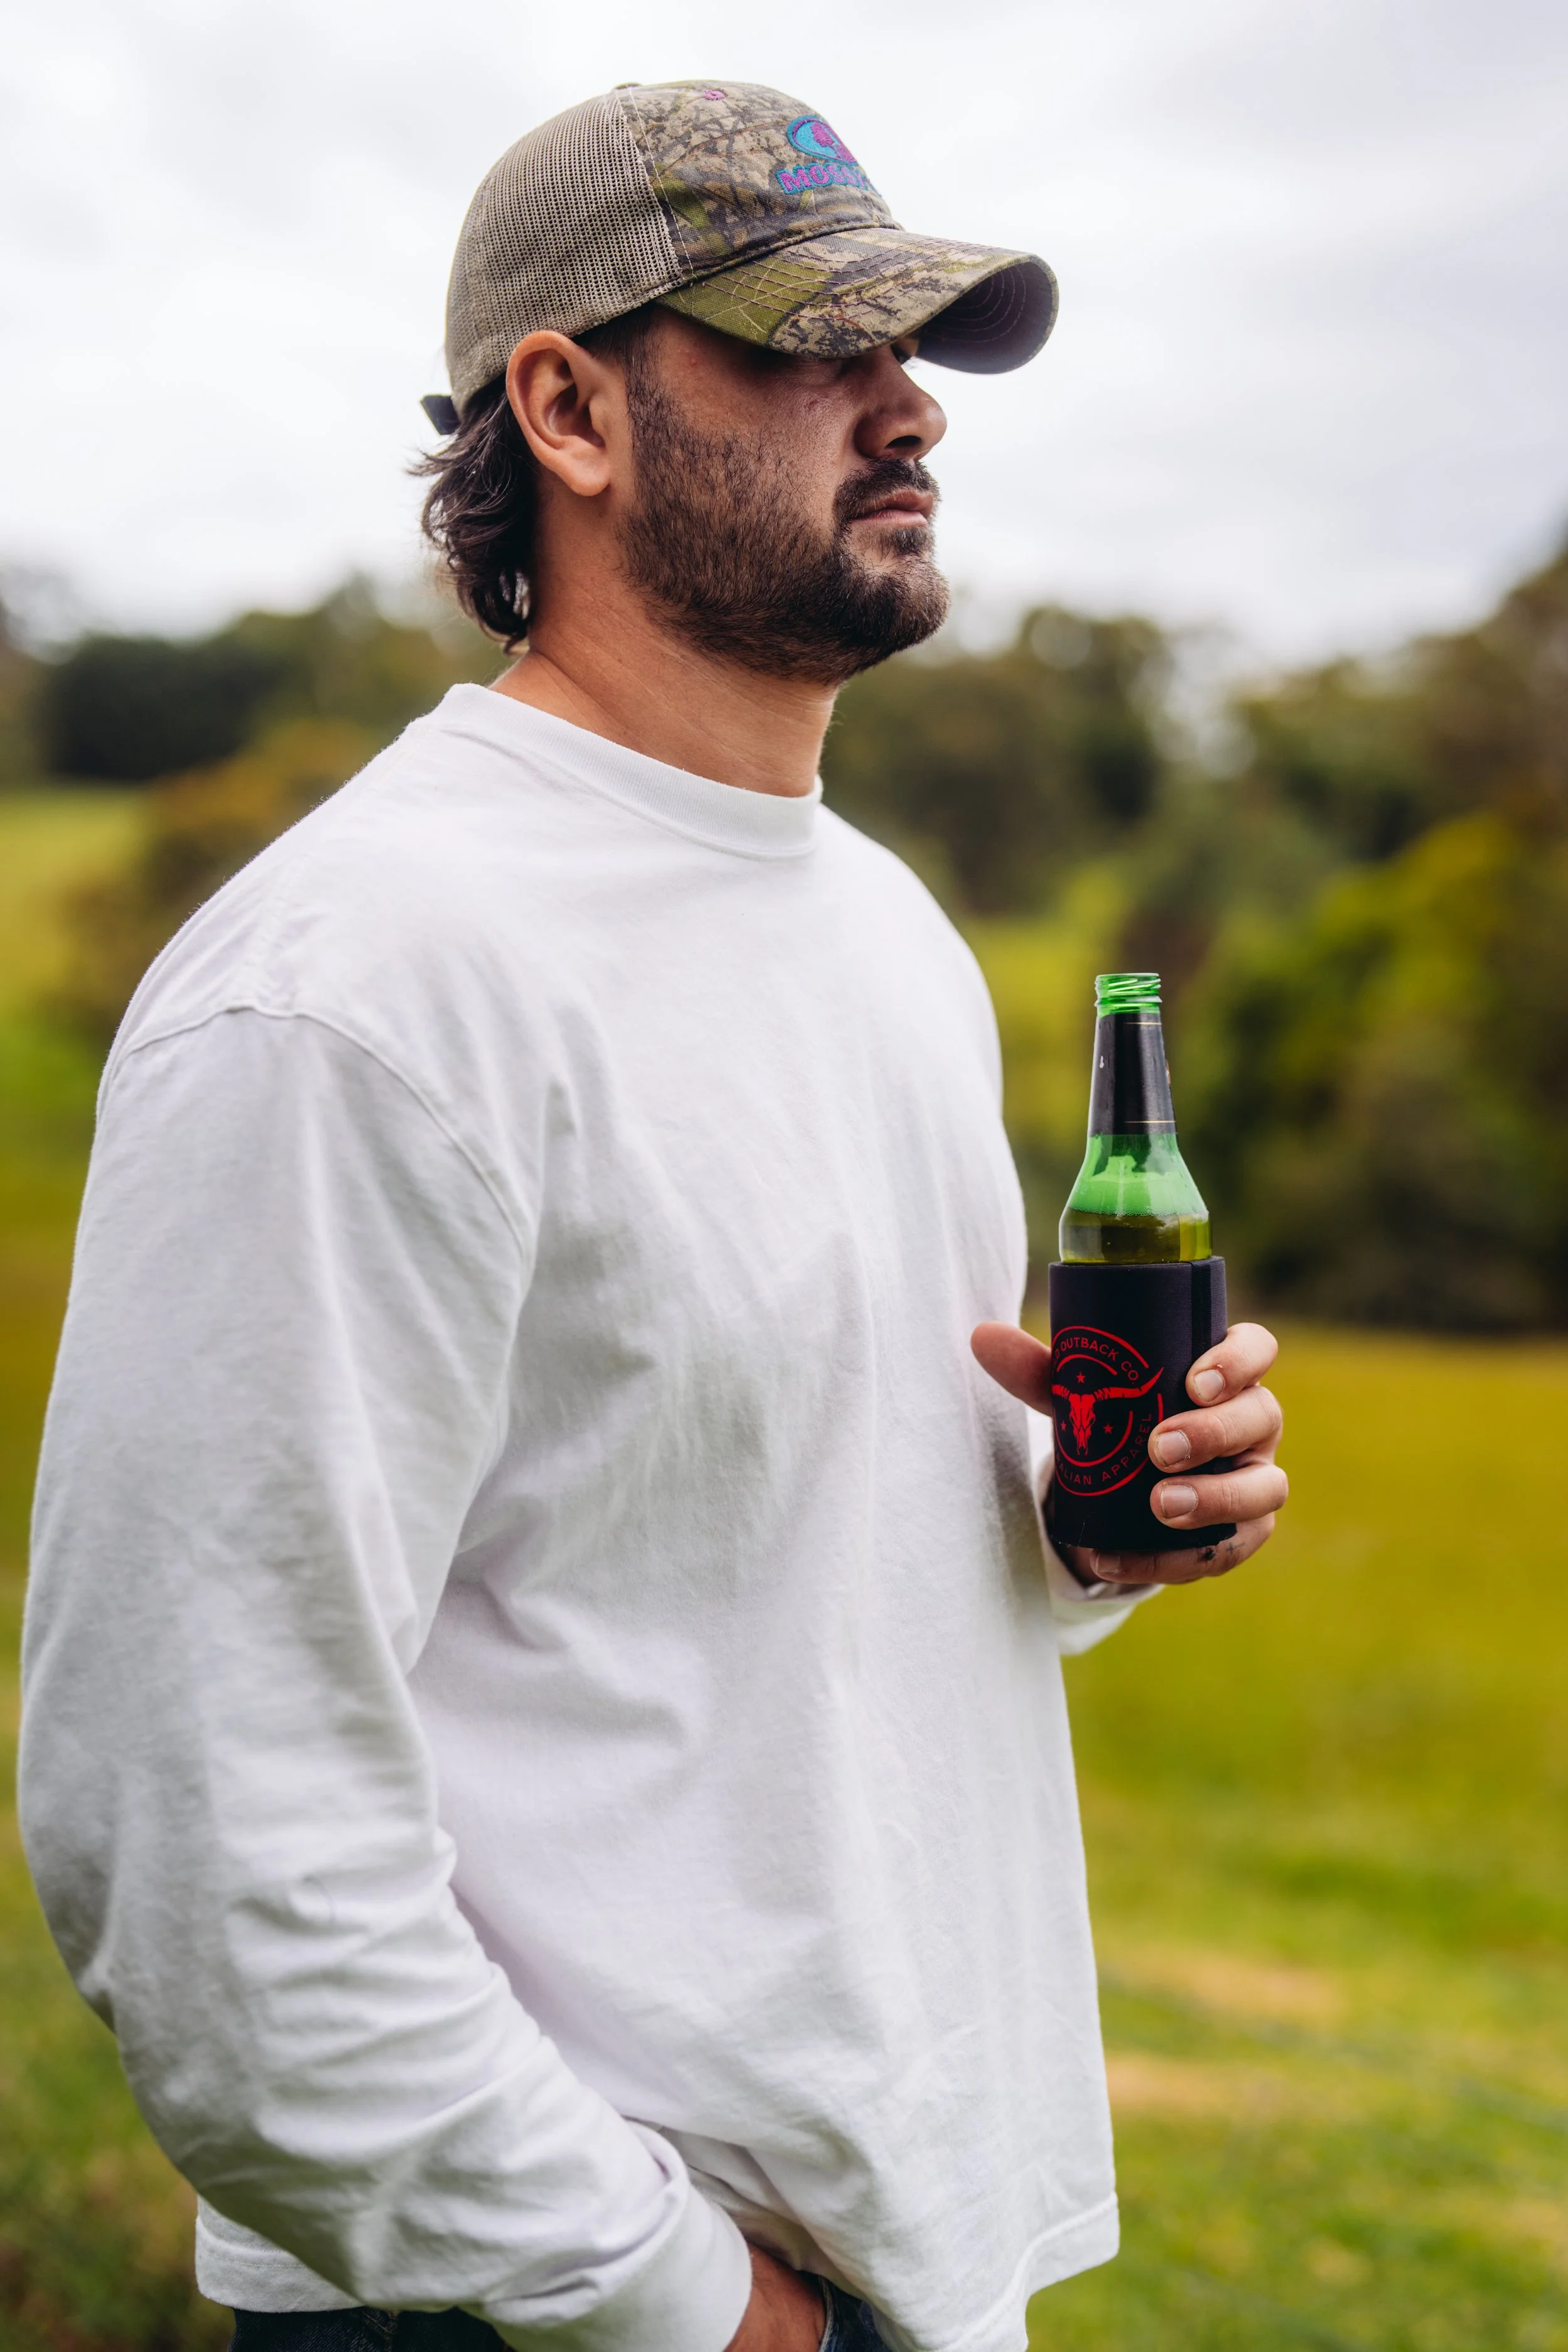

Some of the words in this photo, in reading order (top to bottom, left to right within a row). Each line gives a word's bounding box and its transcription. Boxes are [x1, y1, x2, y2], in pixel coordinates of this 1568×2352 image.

[1060, 1337, 1120, 1362] OUTBACK
[1121, 1360, 1139, 1385] CO.
[1101, 1412, 1152, 1482] APPAREL
